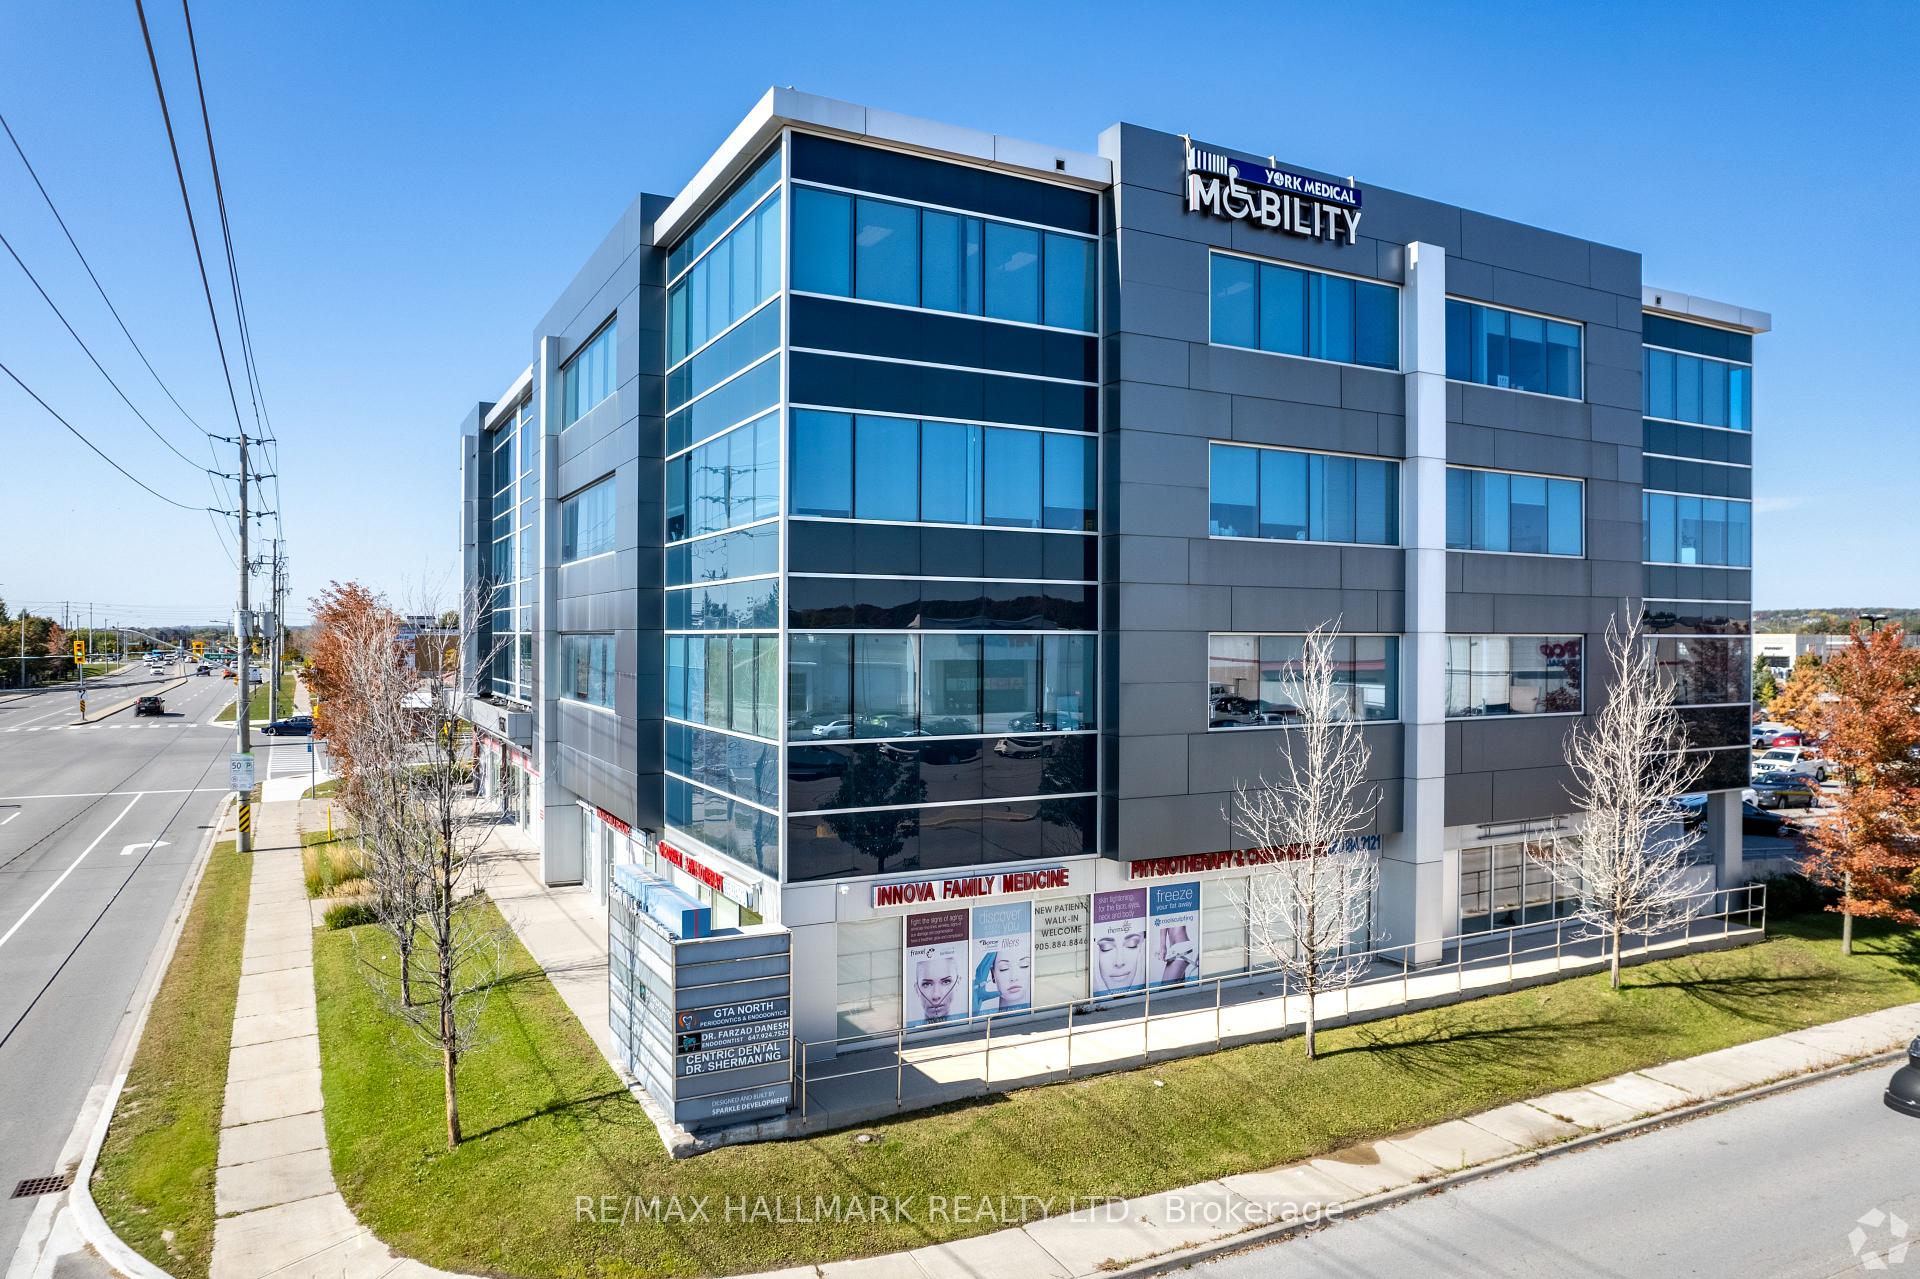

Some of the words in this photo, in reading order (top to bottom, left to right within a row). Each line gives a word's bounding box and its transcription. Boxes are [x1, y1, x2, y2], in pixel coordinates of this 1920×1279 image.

[1265, 169, 1302, 191] YORK
[1304, 179, 1356, 204] MEDICAL
[1130, 849, 1234, 880] PHYSIOTHERAPY
[877, 882, 935, 907] INNOVA
[943, 876, 996, 900] FAMILY
[1003, 868, 1070, 893] MEDICINE
[1157, 888, 1193, 903] freeze
[1034, 905, 1053, 915] NEW
[1156, 904, 1168, 912] your
[1045, 914, 1079, 925] WALK-IN
[1041, 925, 1082, 938] WELCOME
[713, 1007, 735, 1018] GTA
[737, 1001, 774, 1015] NORTH
[747, 1009, 787, 1020] ENDODONTICS
[701, 1032, 717, 1041] DR.
[718, 1027, 753, 1039] FARZAD
[754, 1021, 789, 1033] DANESH
[701, 1036, 744, 1048] ENDODONTIST
[686, 1048, 735, 1065] CENTRIC
[738, 1042, 781, 1056] DENTAL
[685, 1064, 705, 1075] DR.
[708, 1055, 762, 1071] SHERMAN
[765, 1051, 781, 1060] NG
[711, 1097, 739, 1107] DESIGNED
[738, 1094, 753, 1102] AND
[711, 1104, 741, 1116] SPARKLE
[741, 1096, 789, 1110] DEVELOPMENT
